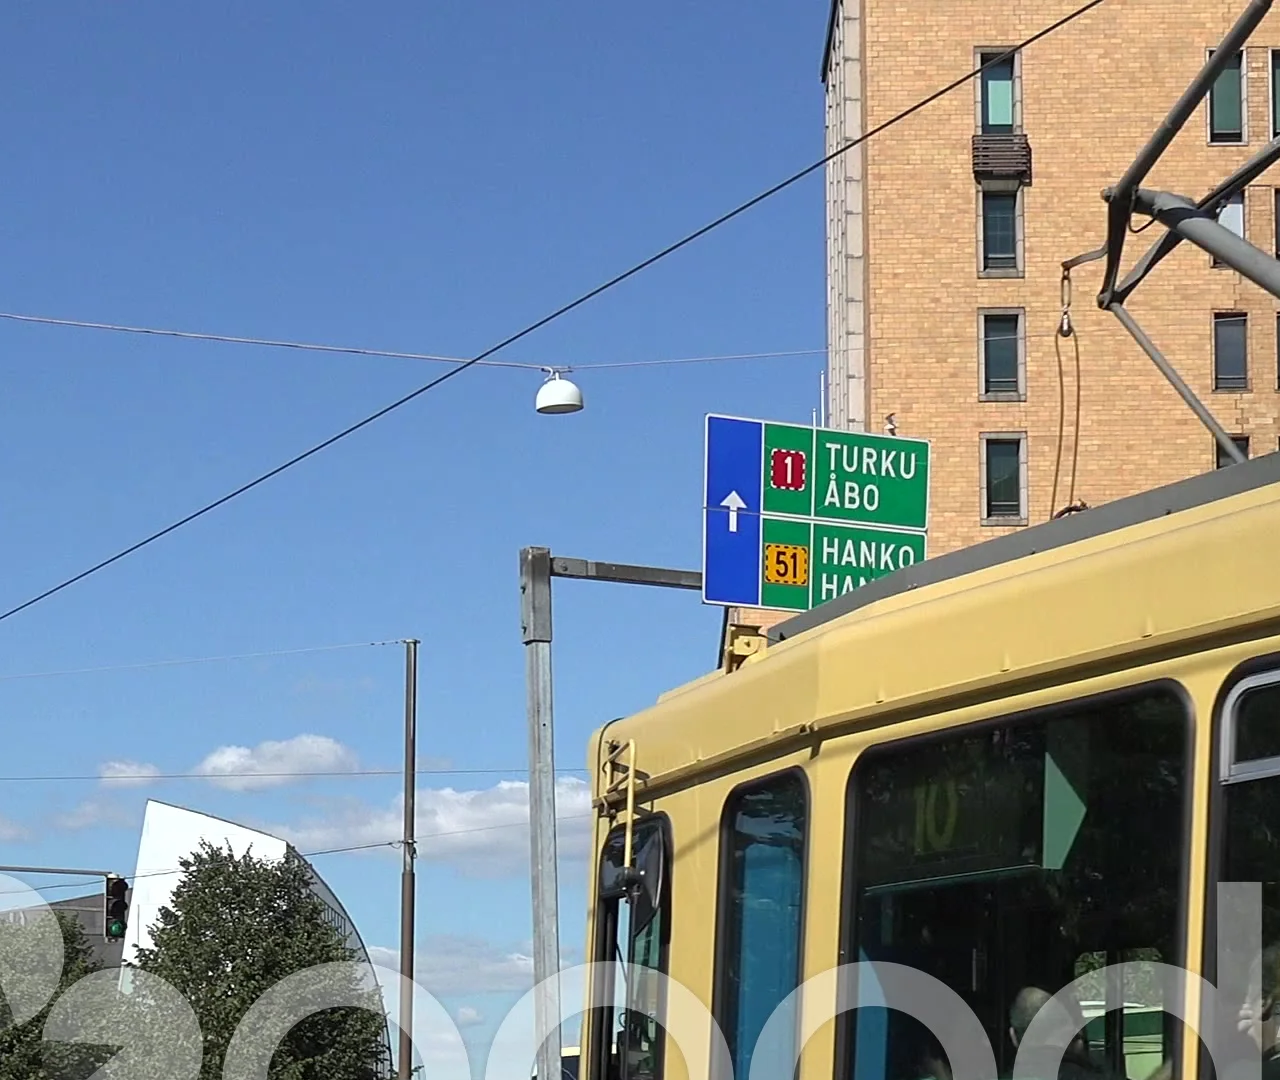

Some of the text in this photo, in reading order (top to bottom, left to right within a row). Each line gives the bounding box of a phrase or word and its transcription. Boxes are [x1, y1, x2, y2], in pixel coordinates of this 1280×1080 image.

[783, 456, 793, 485] 1
[825, 442, 916, 480] TURKU
[824, 472, 879, 512] ÅBO
[774, 550, 798, 579] 51
[822, 536, 915, 571] HANKO
